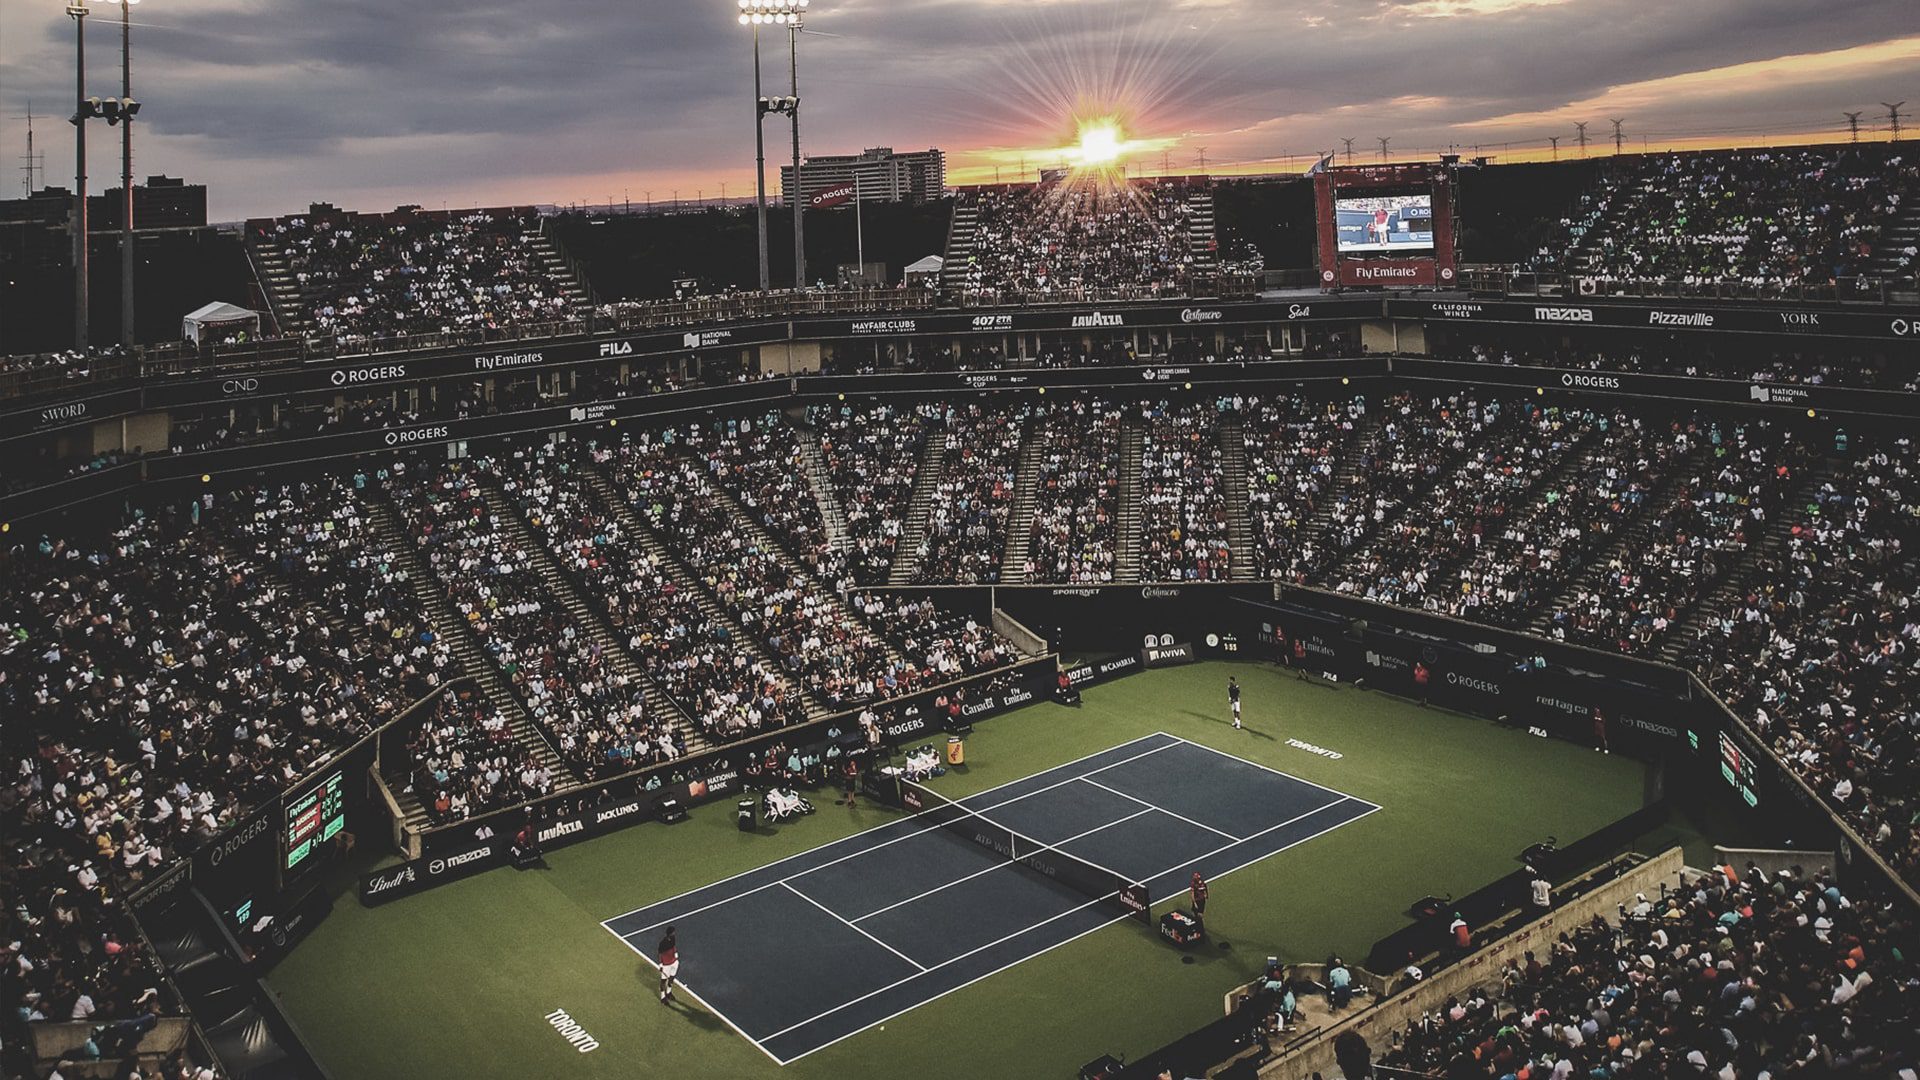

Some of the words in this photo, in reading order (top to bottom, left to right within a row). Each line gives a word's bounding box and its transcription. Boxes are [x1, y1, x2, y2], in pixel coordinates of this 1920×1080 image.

[1356, 267, 1372, 279] Fly
[1374, 266, 1416, 277] Emirates
[1432, 303, 1482, 312] CALIFORNIA
[1535, 306, 1593, 322] mazda
[852, 321, 887, 330] MAYFAIR
[888, 319, 916, 329] CLUBS
[972, 315, 996, 326] 407
[1072, 311, 1124, 328] LAVAZZA
[1650, 311, 1714, 328] Pizzaville
[1781, 312, 1819, 325] YORK
[702, 330, 732, 339] NATIONAL
[702, 338, 720, 346] BANK
[600, 342, 632, 357] FILA
[475, 358, 496, 372] Fly
[497, 353, 543, 368] Emirates
[349, 365, 405, 384] ROGERS
[1575, 375, 1620, 389] ROGERS
[222, 378, 259, 394] CND
[1771, 387, 1808, 397] NATIONAL
[1771, 394, 1793, 403] BANK
[586, 404, 616, 413] NATIONAL
[586, 411, 605, 419] BANK
[399, 426, 448, 442] ROGERS
[1160, 648, 1186, 658] AVIVA
[1322, 671, 1338, 682] FILA
[1459, 676, 1501, 696] ROGERS
[1003, 691, 1032, 706] Emirates
[961, 697, 996, 716] Canada
[888, 719, 925, 737] ROGERS
[1529, 726, 1548, 742] FILA
[1284, 738, 1344, 759] TORONTO
[706, 770, 738, 786] NATIONAL
[709, 781, 729, 793] BANK
[596, 809, 617, 824] JACK
[225, 814, 268, 855] ROGERS
[538, 820, 584, 843] LAVAZZA
[975, 833, 992, 846] ATP
[447, 845, 493, 869] mazda
[366, 868, 406, 896] Lindt
[1161, 923, 1184, 944] FedEx
[544, 1007, 600, 1053] TORONTO
